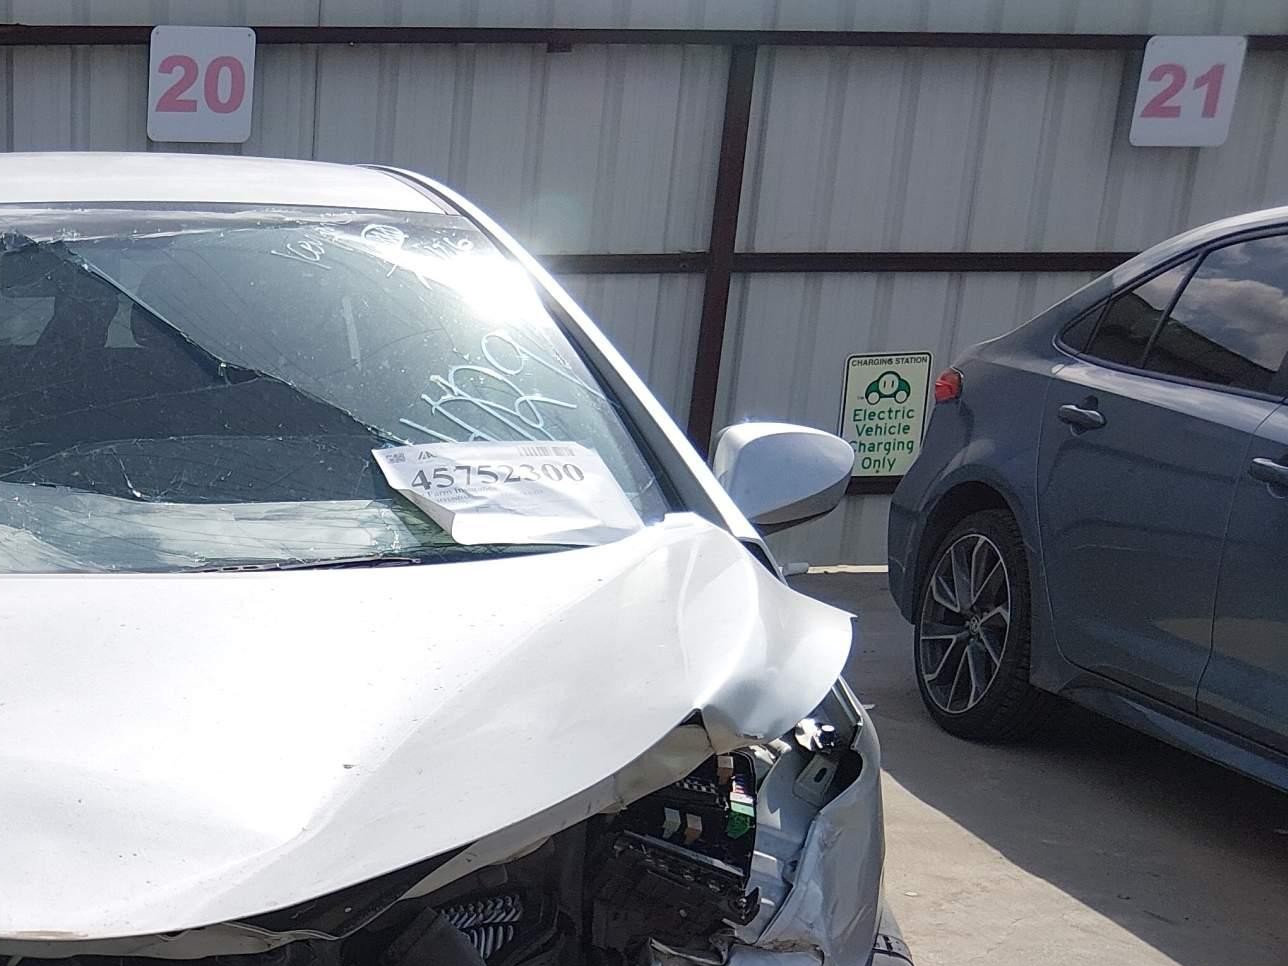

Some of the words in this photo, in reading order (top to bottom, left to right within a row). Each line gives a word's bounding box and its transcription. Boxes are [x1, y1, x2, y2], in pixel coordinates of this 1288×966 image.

[155, 54, 246, 114] 20
[1140, 63, 1226, 119] 21
[852, 358, 893, 367] CHARGING
[895, 356, 928, 365] STATION
[853, 406, 916, 422] Electric
[855, 422, 911, 437] Vehicle
[861, 456, 897, 472] Only
[411, 463, 585, 491] 45752300
